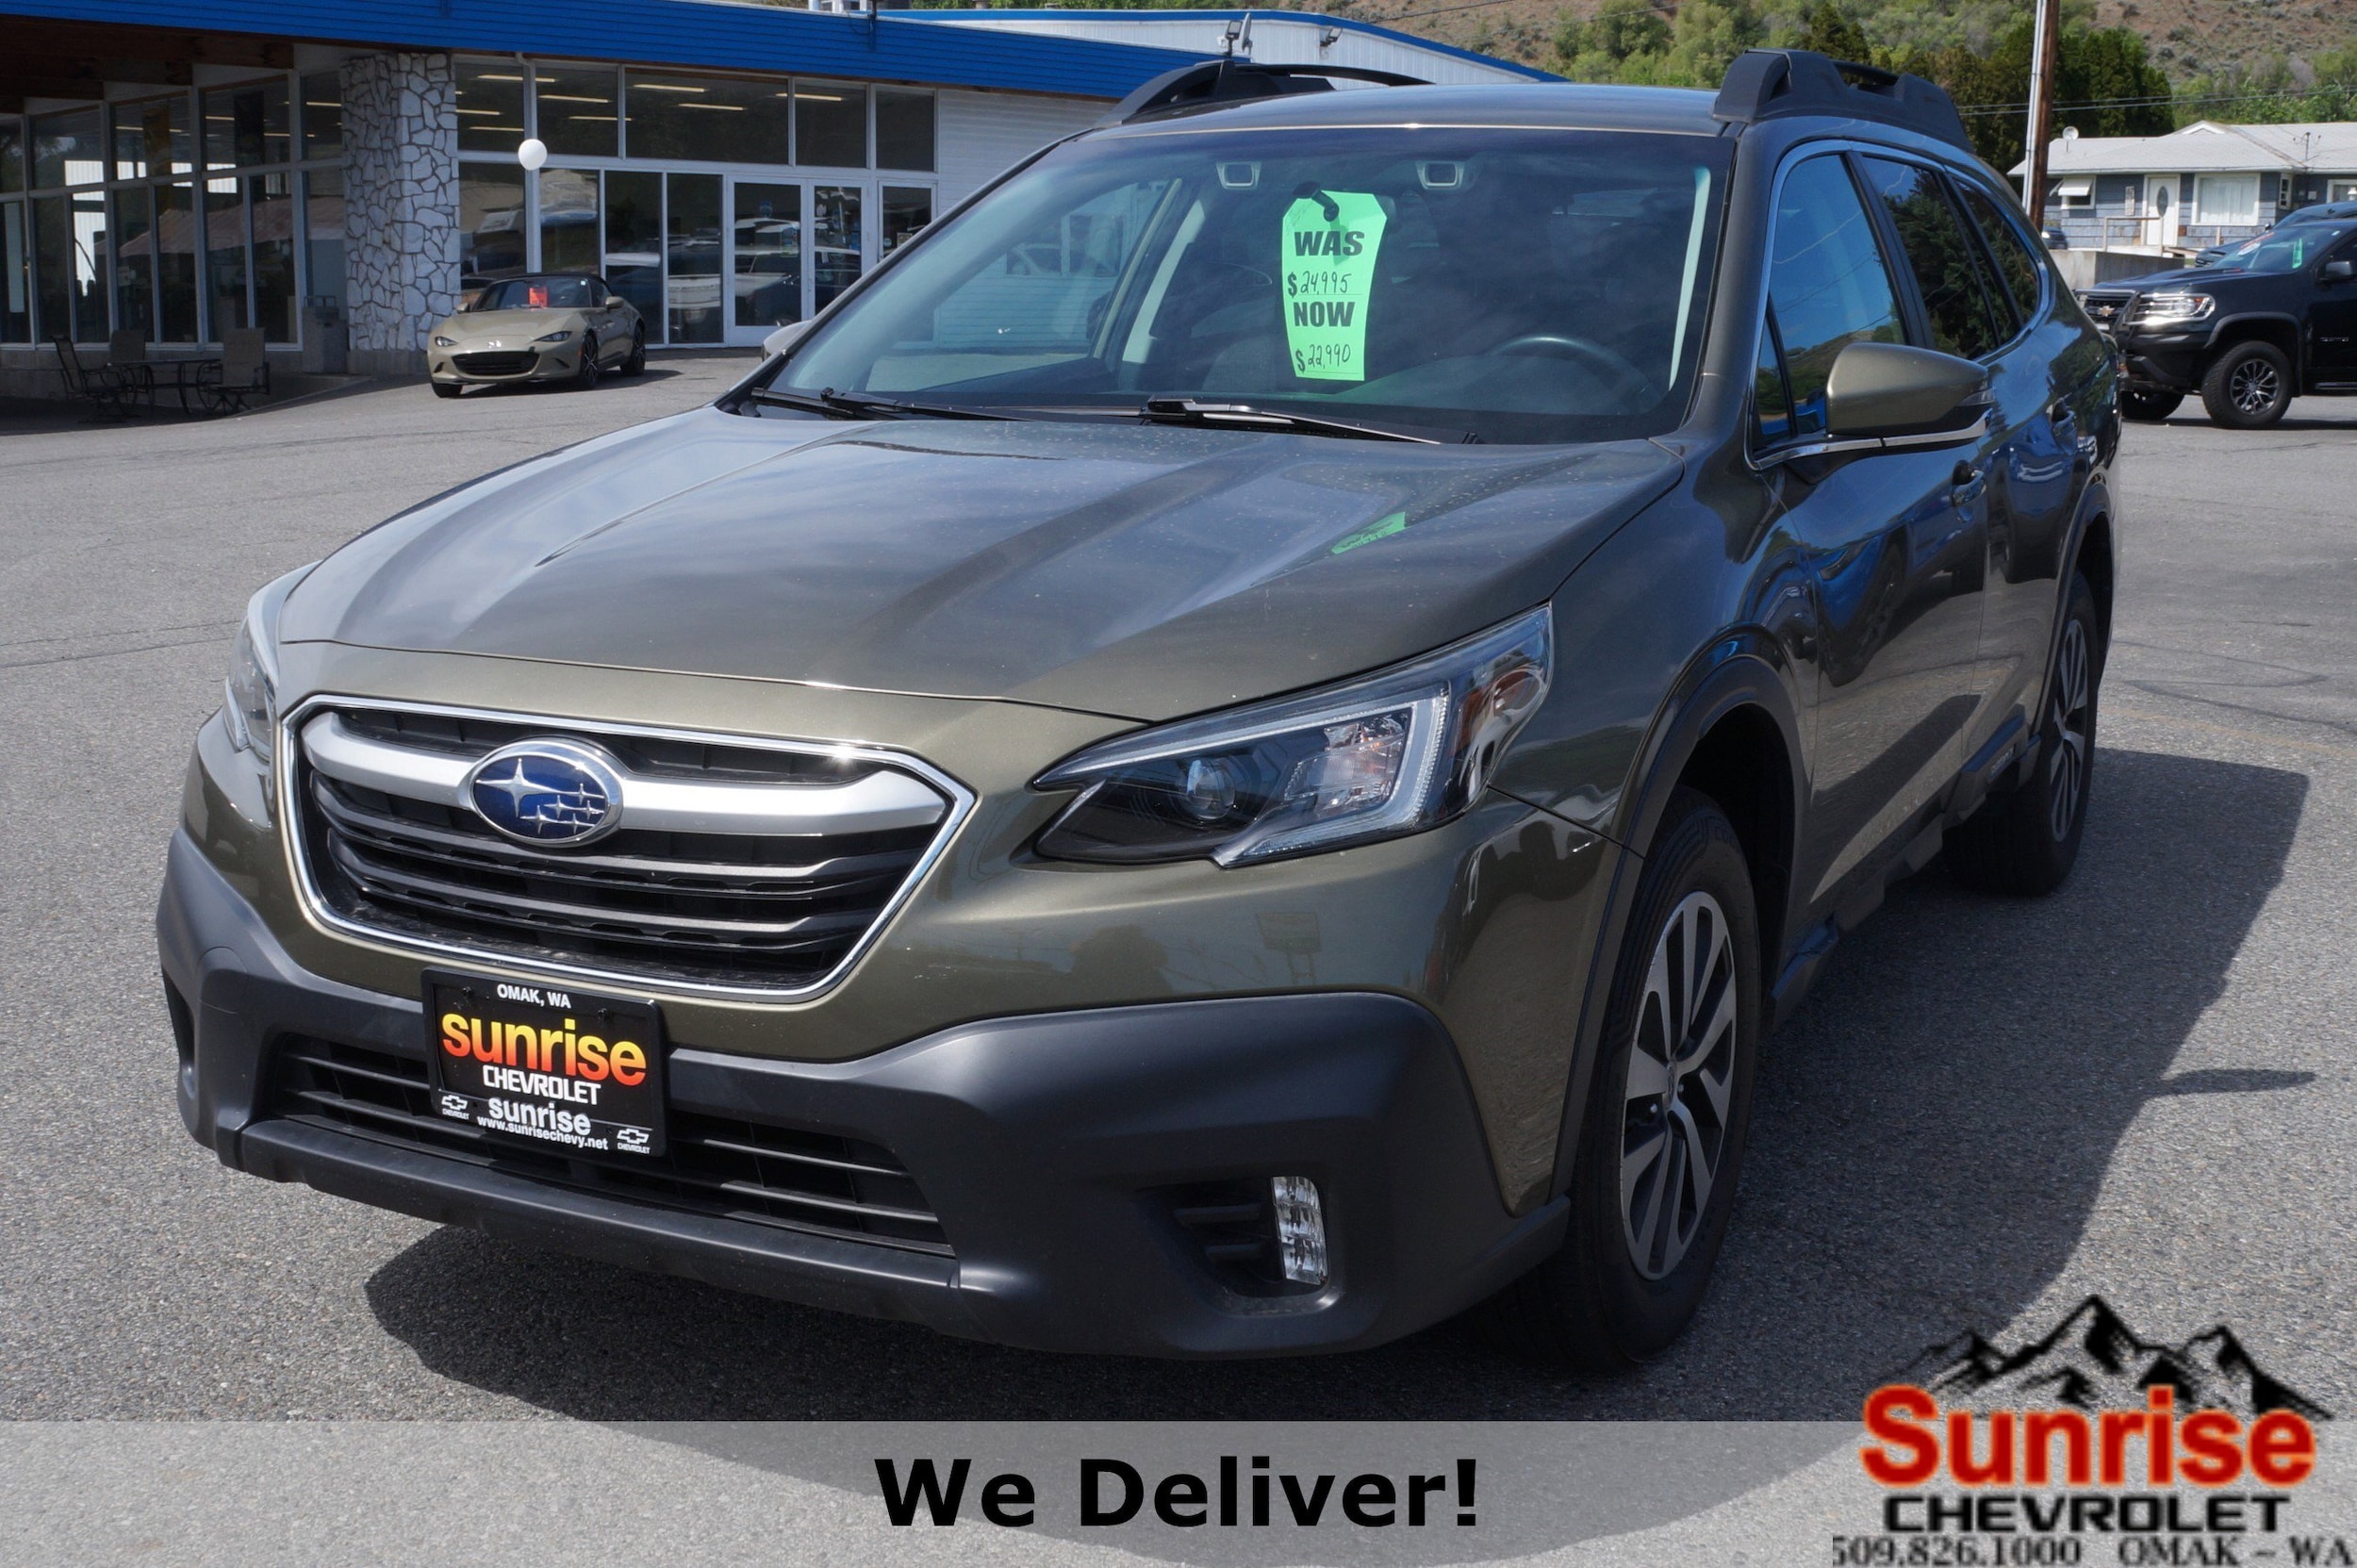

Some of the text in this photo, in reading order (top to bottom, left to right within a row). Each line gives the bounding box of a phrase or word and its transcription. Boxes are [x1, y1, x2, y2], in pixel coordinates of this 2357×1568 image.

[1294, 231, 1364, 256] WAS
[1294, 301, 1355, 327] NOW
[497, 983, 571, 1009] OMAK, WA
[442, 1013, 646, 1086] sunrise
[483, 1065, 602, 1105] CHEVROLET
[488, 1097, 591, 1136] sunrise
[477, 1115, 608, 1150] www.sunrisechevy.net
[617, 1142, 651, 1155] CHEVROLET
